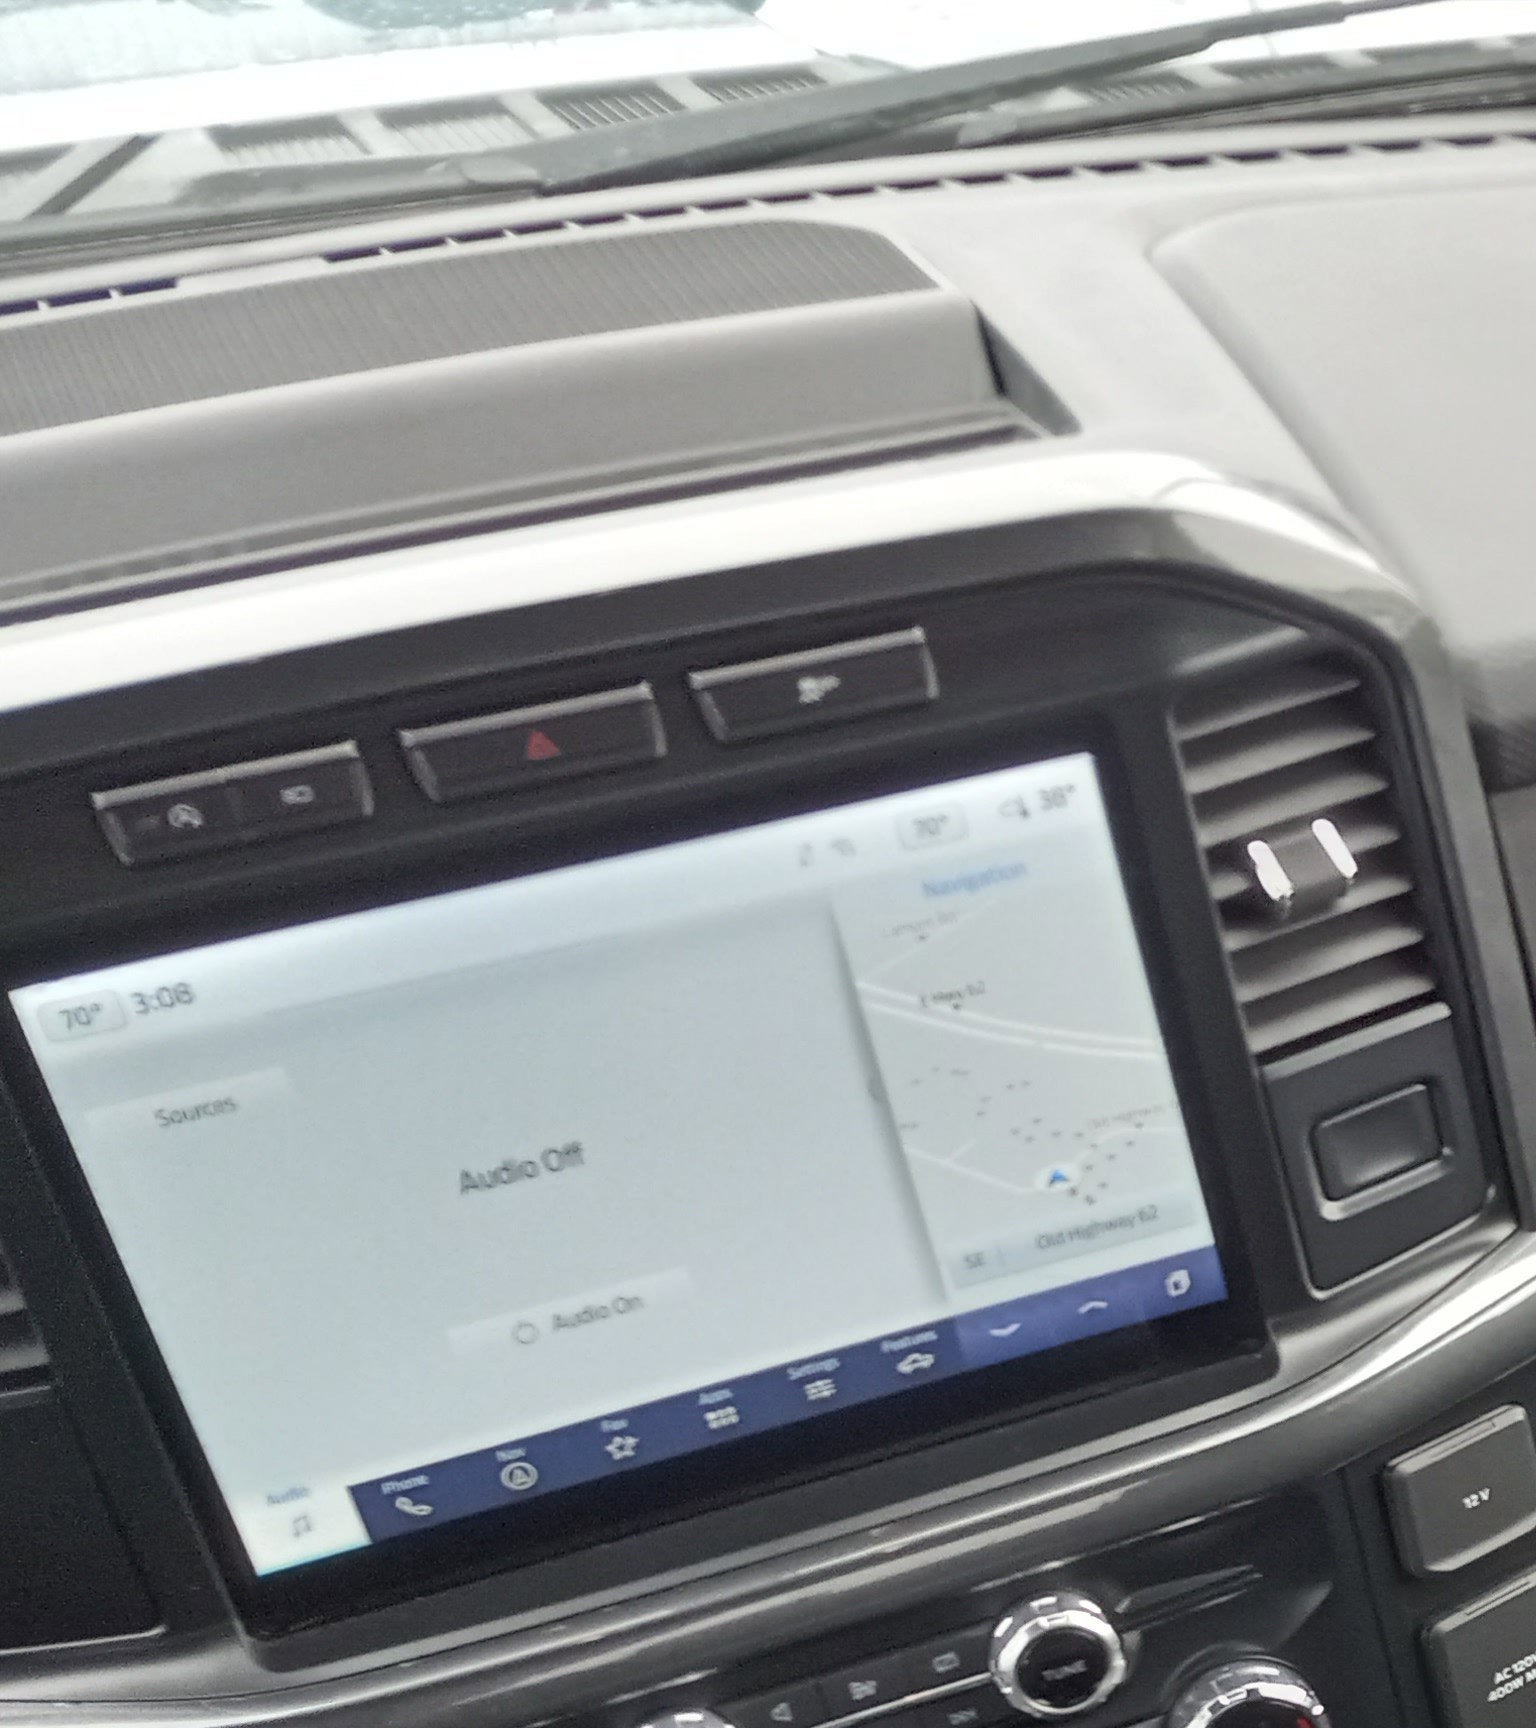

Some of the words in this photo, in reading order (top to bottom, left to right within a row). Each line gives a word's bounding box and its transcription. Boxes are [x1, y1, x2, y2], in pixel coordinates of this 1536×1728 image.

[921, 861, 1028, 897] Navigation
[130, 981, 196, 1015] 3:08
[58, 1002, 104, 1031] 70°
[154, 1097, 240, 1128] Sources
[458, 1157, 541, 1196] Audio
[541, 1140, 585, 1173] Off
[1036, 1231, 1066, 1250] Old
[1067, 1214, 1137, 1244] Highway
[1136, 1203, 1158, 1223] 62
[552, 1304, 611, 1332] Audio
[611, 1295, 644, 1316] On
[381, 1473, 431, 1496] Phone
[1487, 1675, 1524, 1702] 400W
[1493, 1666, 1513, 1685] AC
